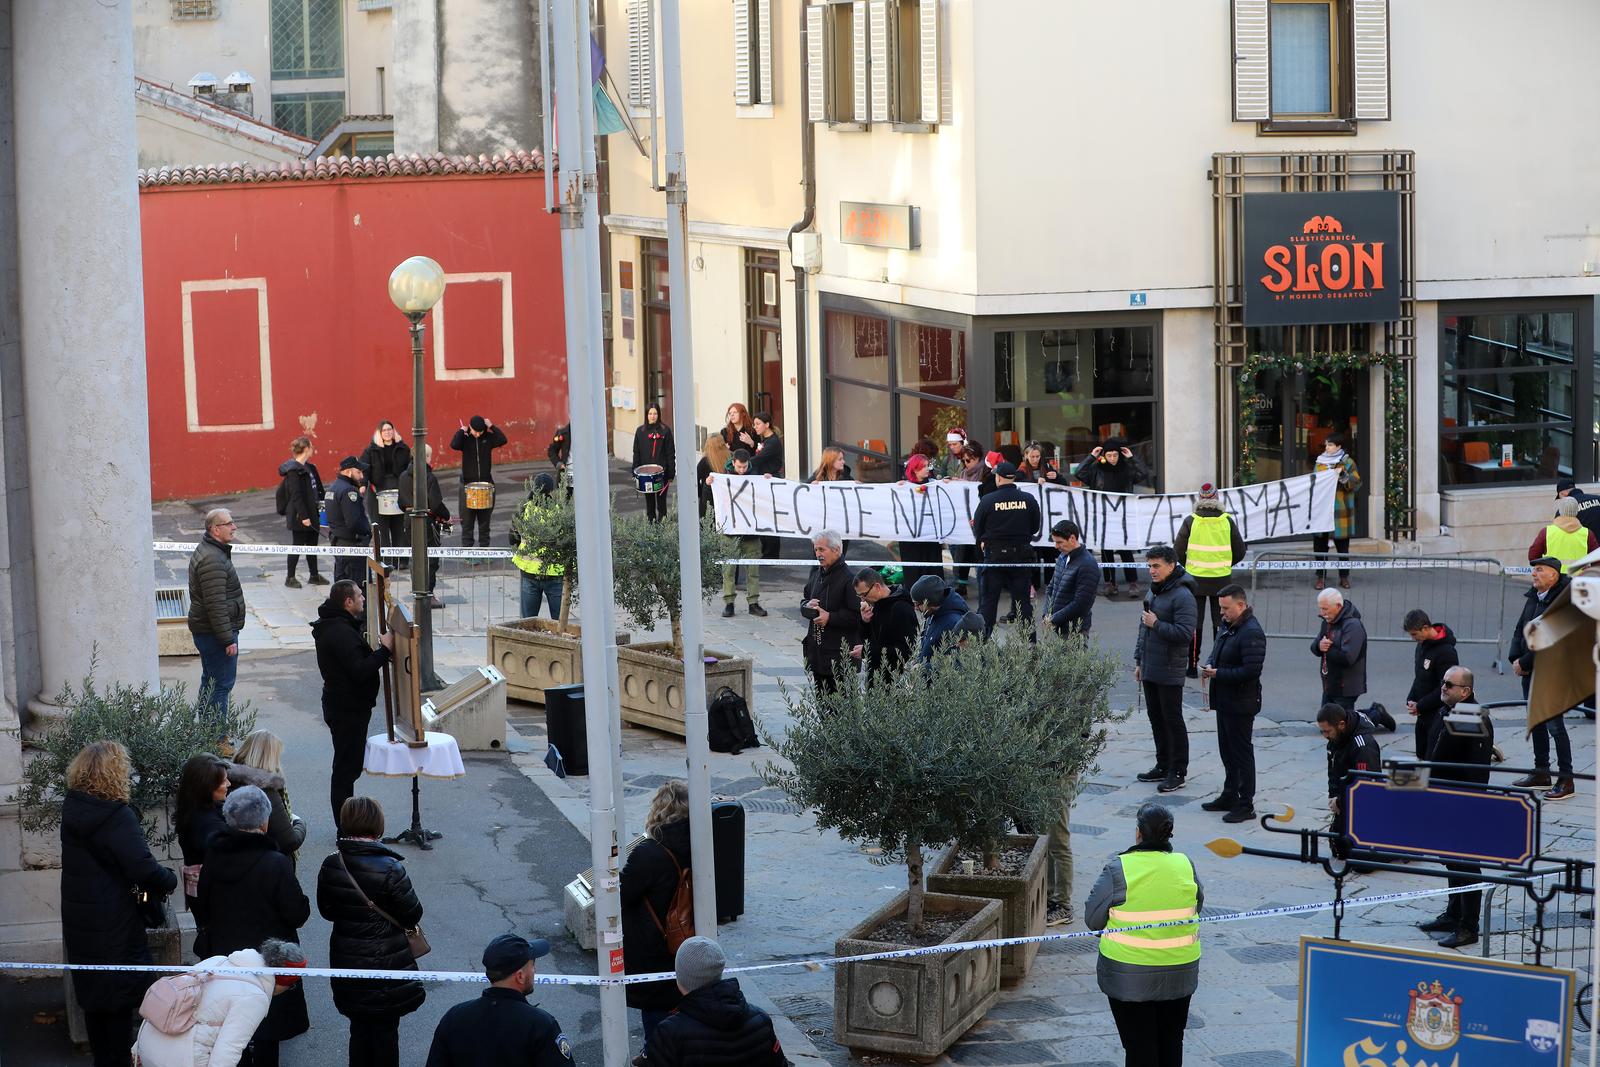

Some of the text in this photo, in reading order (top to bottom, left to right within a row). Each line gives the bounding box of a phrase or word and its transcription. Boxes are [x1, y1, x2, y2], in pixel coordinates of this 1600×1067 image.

[1259, 242, 1385, 293] SLON
[890, 485, 957, 539] NAD
[963, 484, 1128, 550] JENIM
[1137, 473, 1317, 547] ZEAMA!
[994, 500, 1027, 511] POLICIJA
[1577, 498, 1600, 512] LICIJA
